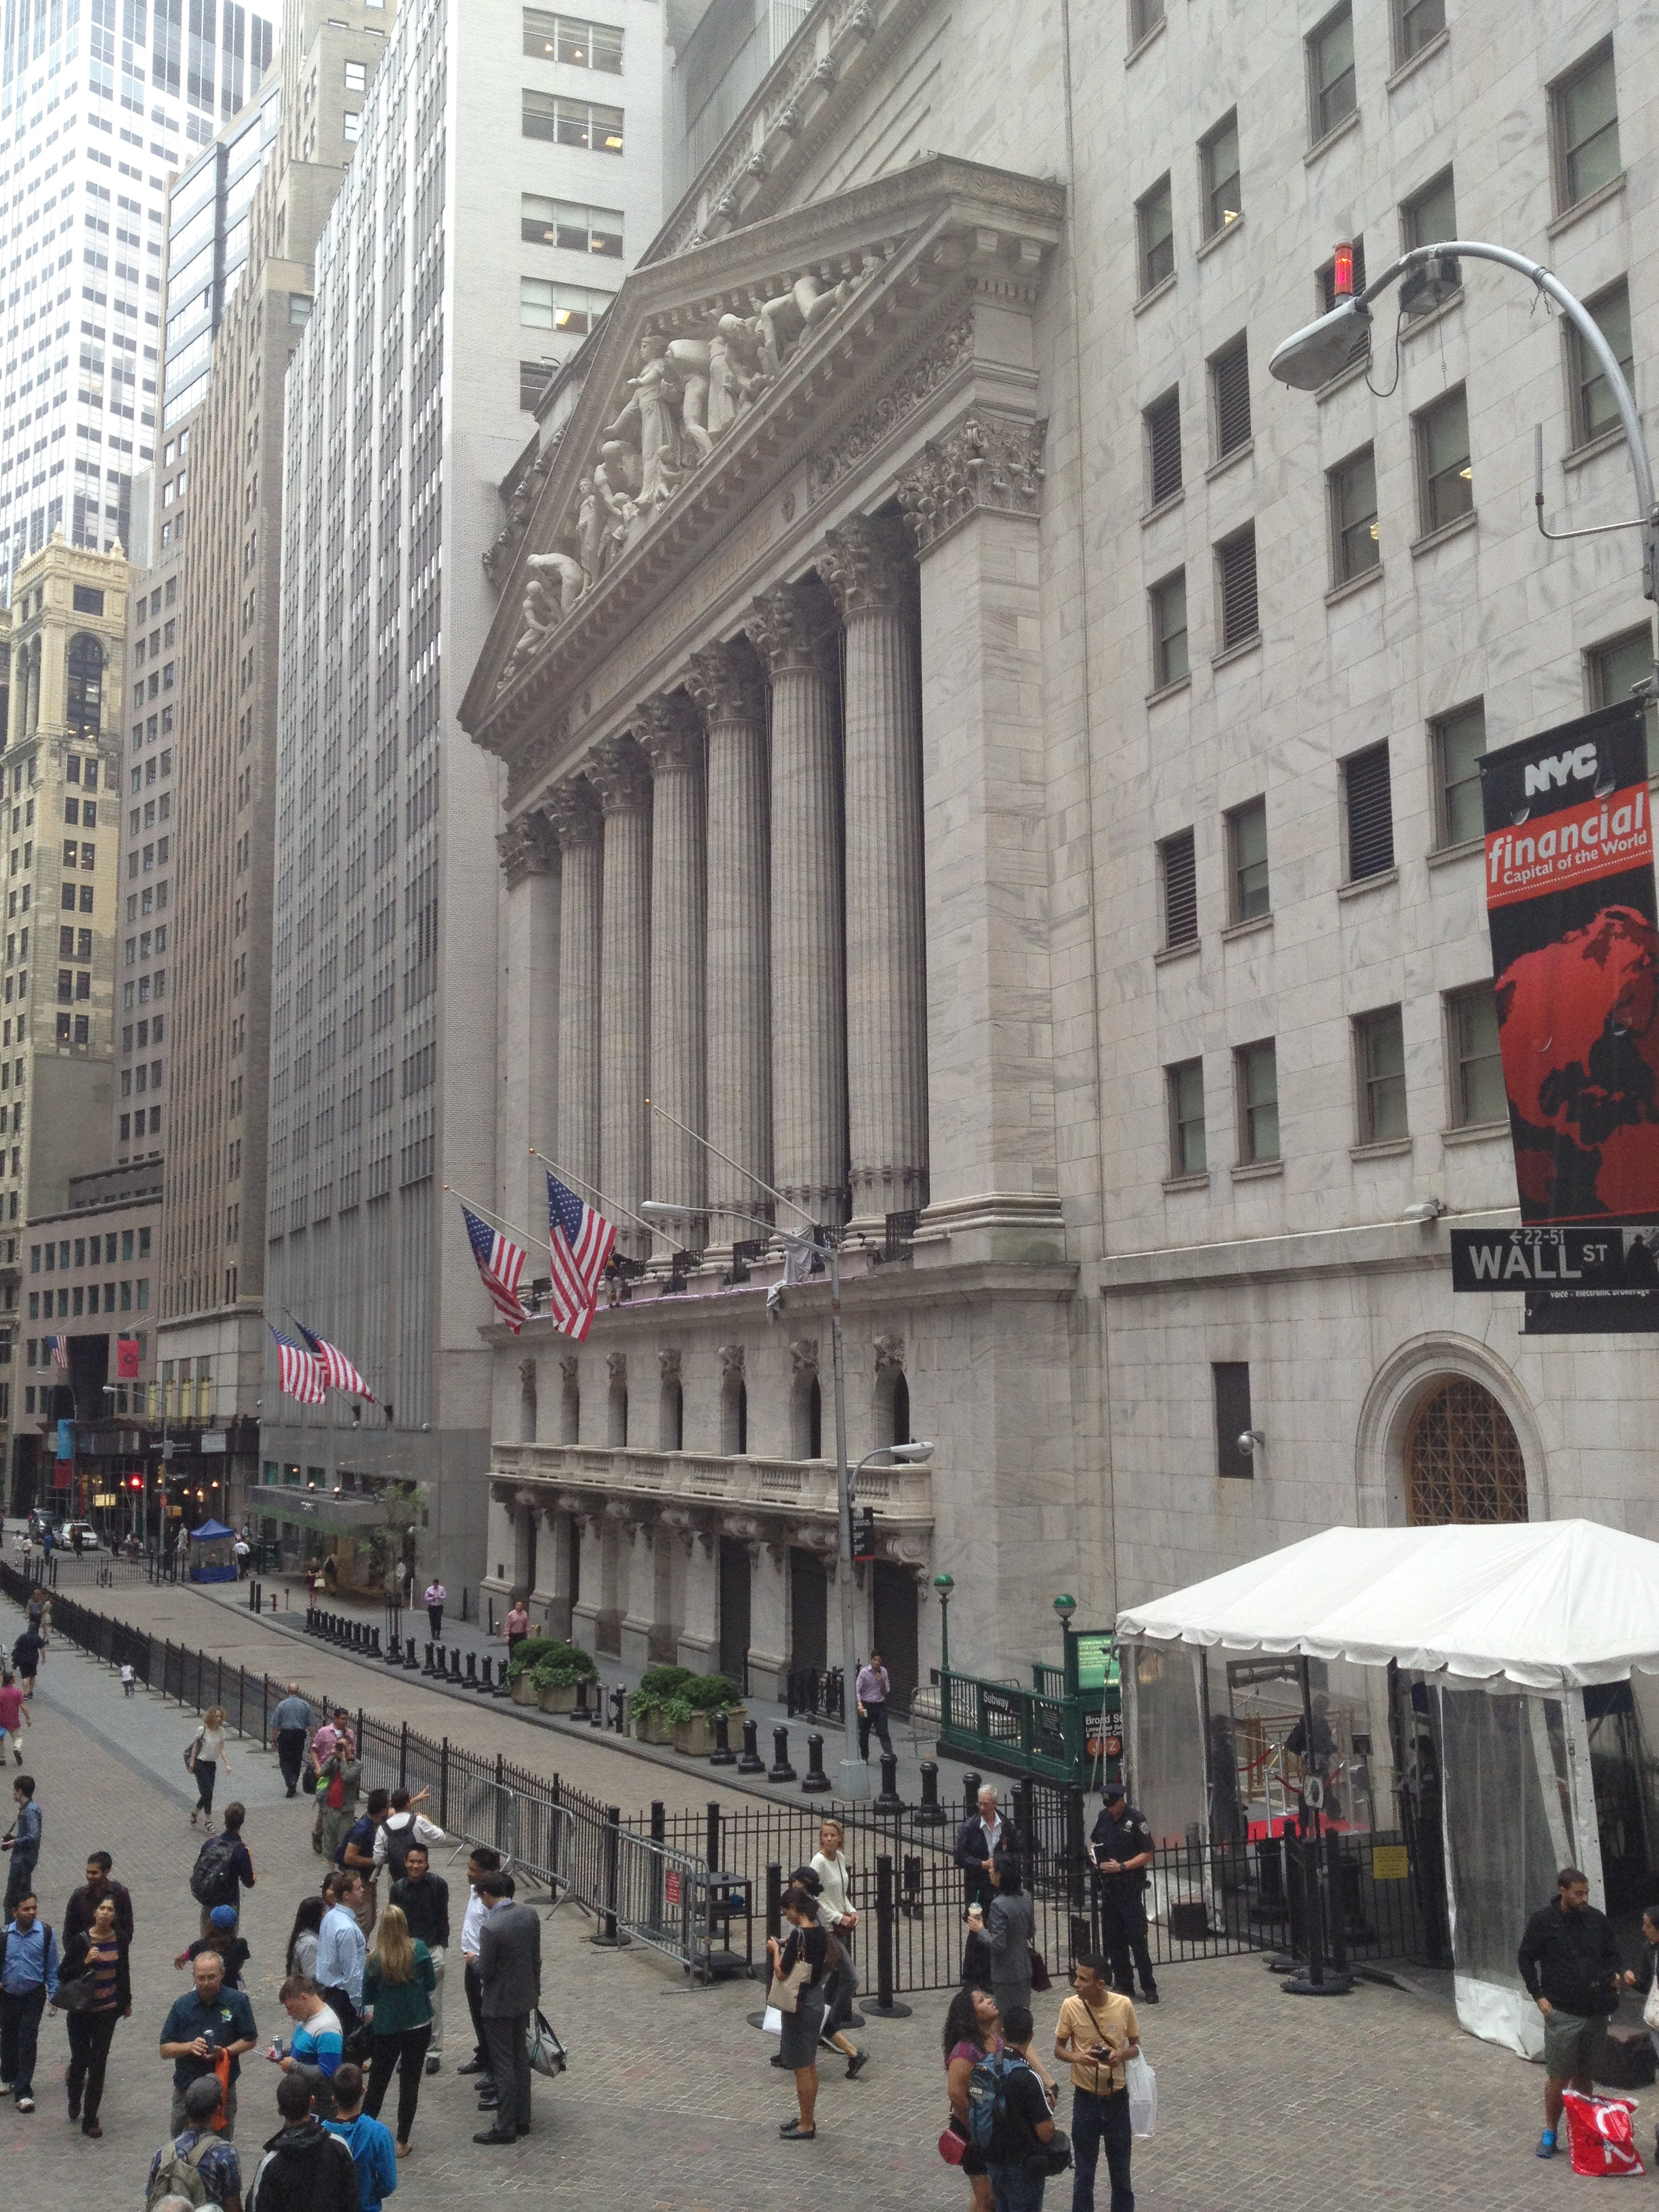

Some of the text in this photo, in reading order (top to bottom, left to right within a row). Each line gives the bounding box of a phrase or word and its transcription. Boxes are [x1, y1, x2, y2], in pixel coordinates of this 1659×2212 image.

[1525, 743, 1598, 796] NYC
[1489, 792, 1644, 883] financial
[1503, 830, 1647, 885] Capital of the World
[1524, 1229, 1565, 1246] 22-51
[1469, 1244, 1608, 1280] WALL ST
[1551, 1290, 1569, 1298] voice
[983, 1690, 1009, 1711] Subway
[1086, 1715, 1111, 1725] Brod
[1109, 1740, 1117, 1751] Z
